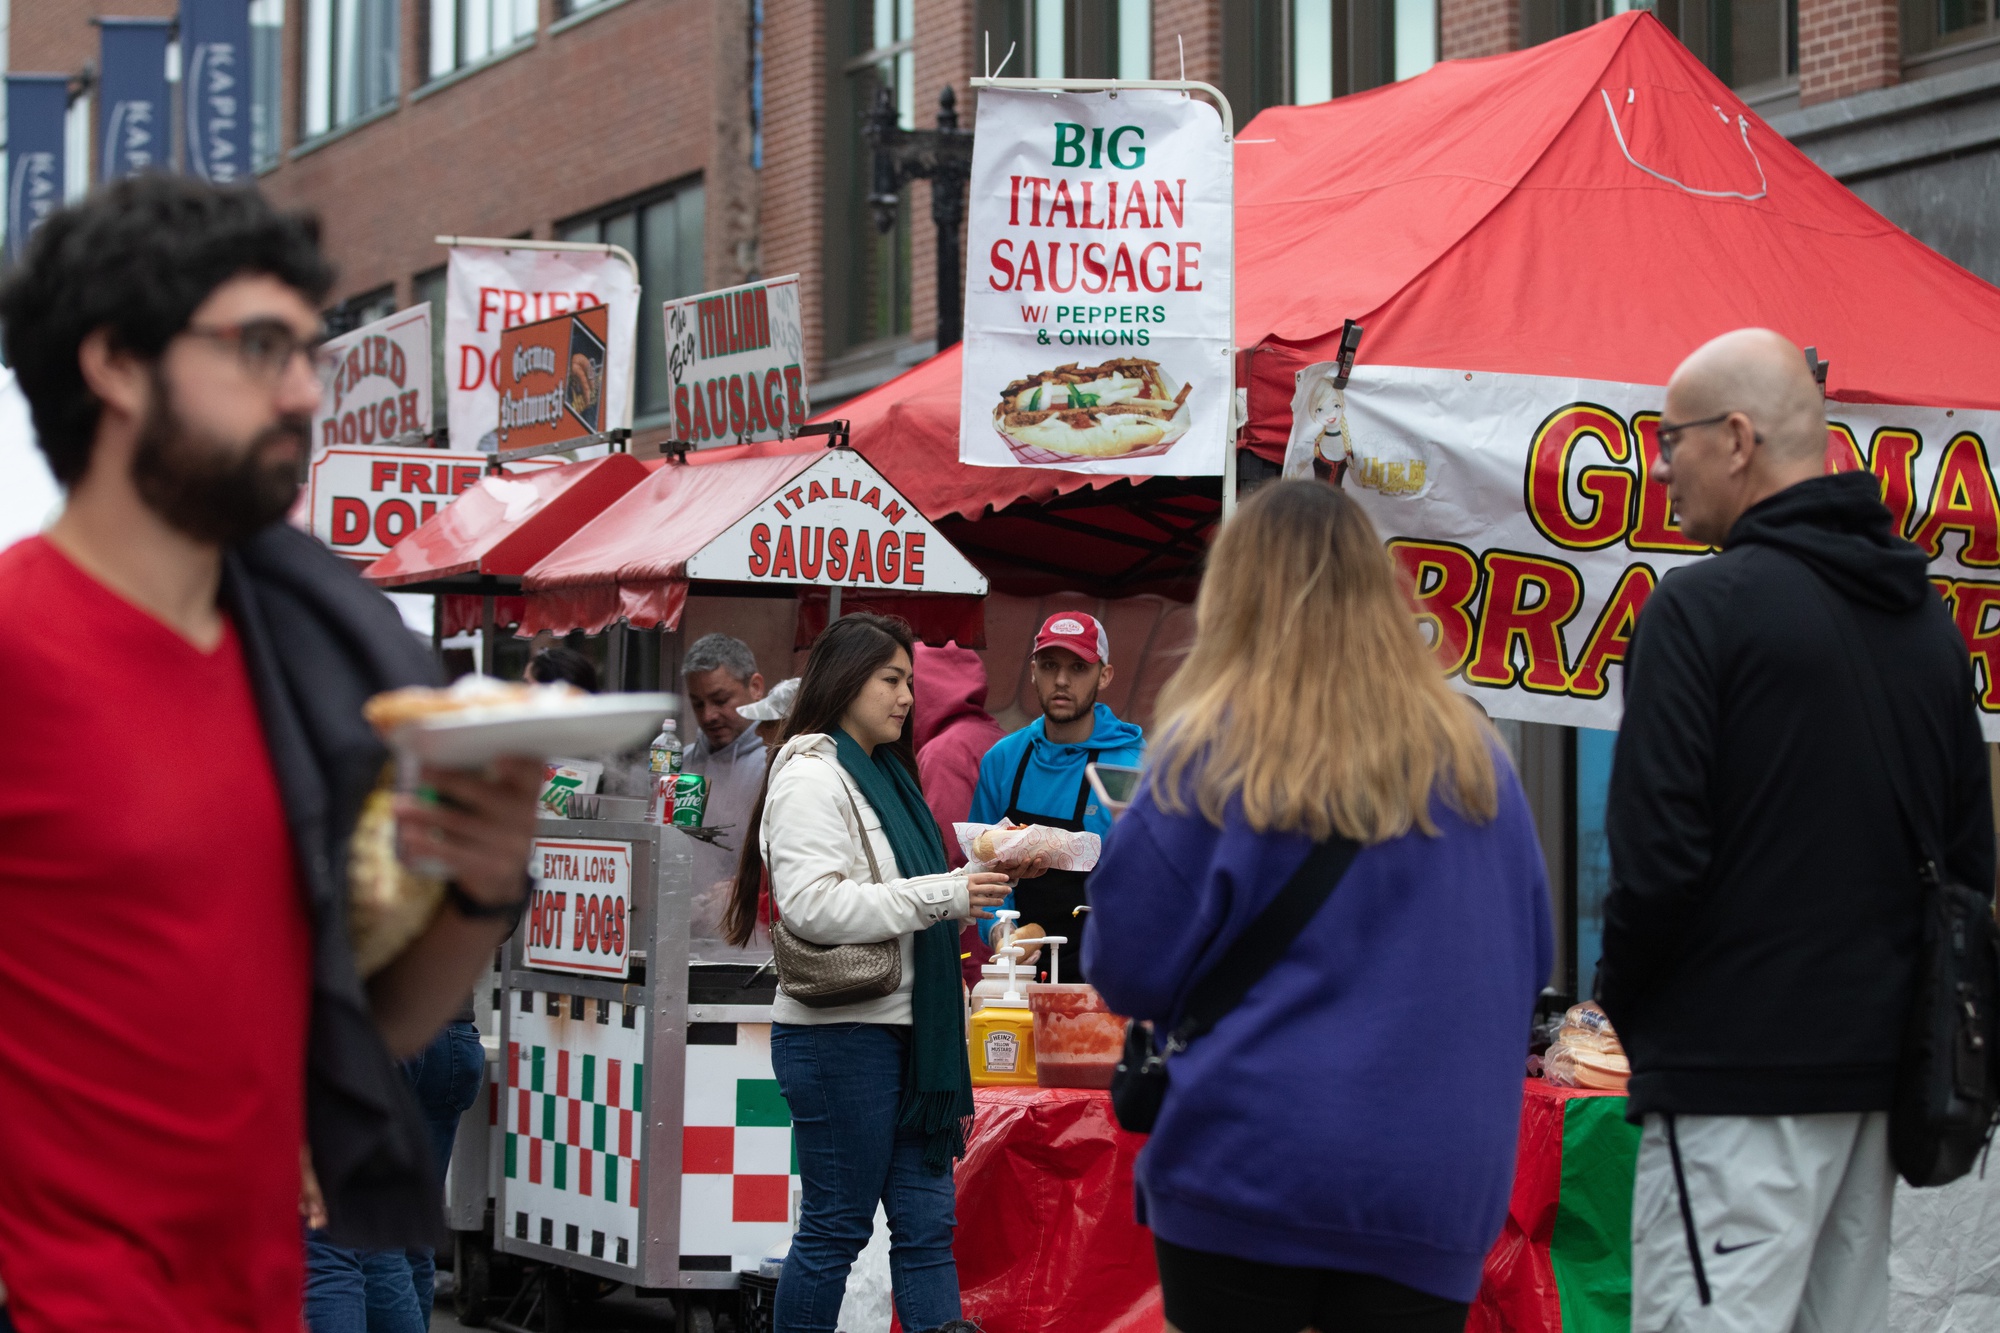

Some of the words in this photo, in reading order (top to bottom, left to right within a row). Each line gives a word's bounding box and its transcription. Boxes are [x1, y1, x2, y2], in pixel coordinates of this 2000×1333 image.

[1052, 122, 1146, 170] BIG
[1008, 175, 1187, 230] ITALIAN
[989, 238, 1203, 294] SAUSAGE
[697, 286, 771, 360] ITALIAN
[1021, 305, 1048, 323] W/
[1056, 305, 1166, 323] PEPPERS
[1036, 329, 1051, 345] &
[1059, 329, 1151, 346] ONIONS
[334, 334, 407, 416] FRIED
[669, 333, 696, 385] Big
[322, 388, 419, 447] DOUGH
[674, 363, 806, 442] SAUSAGE
[773, 477, 907, 527] ITALIAN
[748, 522, 926, 585] SAUSAGE
[543, 853, 580, 881] EXTRA
[584, 855, 616, 884] LONG
[529, 889, 567, 950] HOT
[573, 892, 625, 957] DOGS
